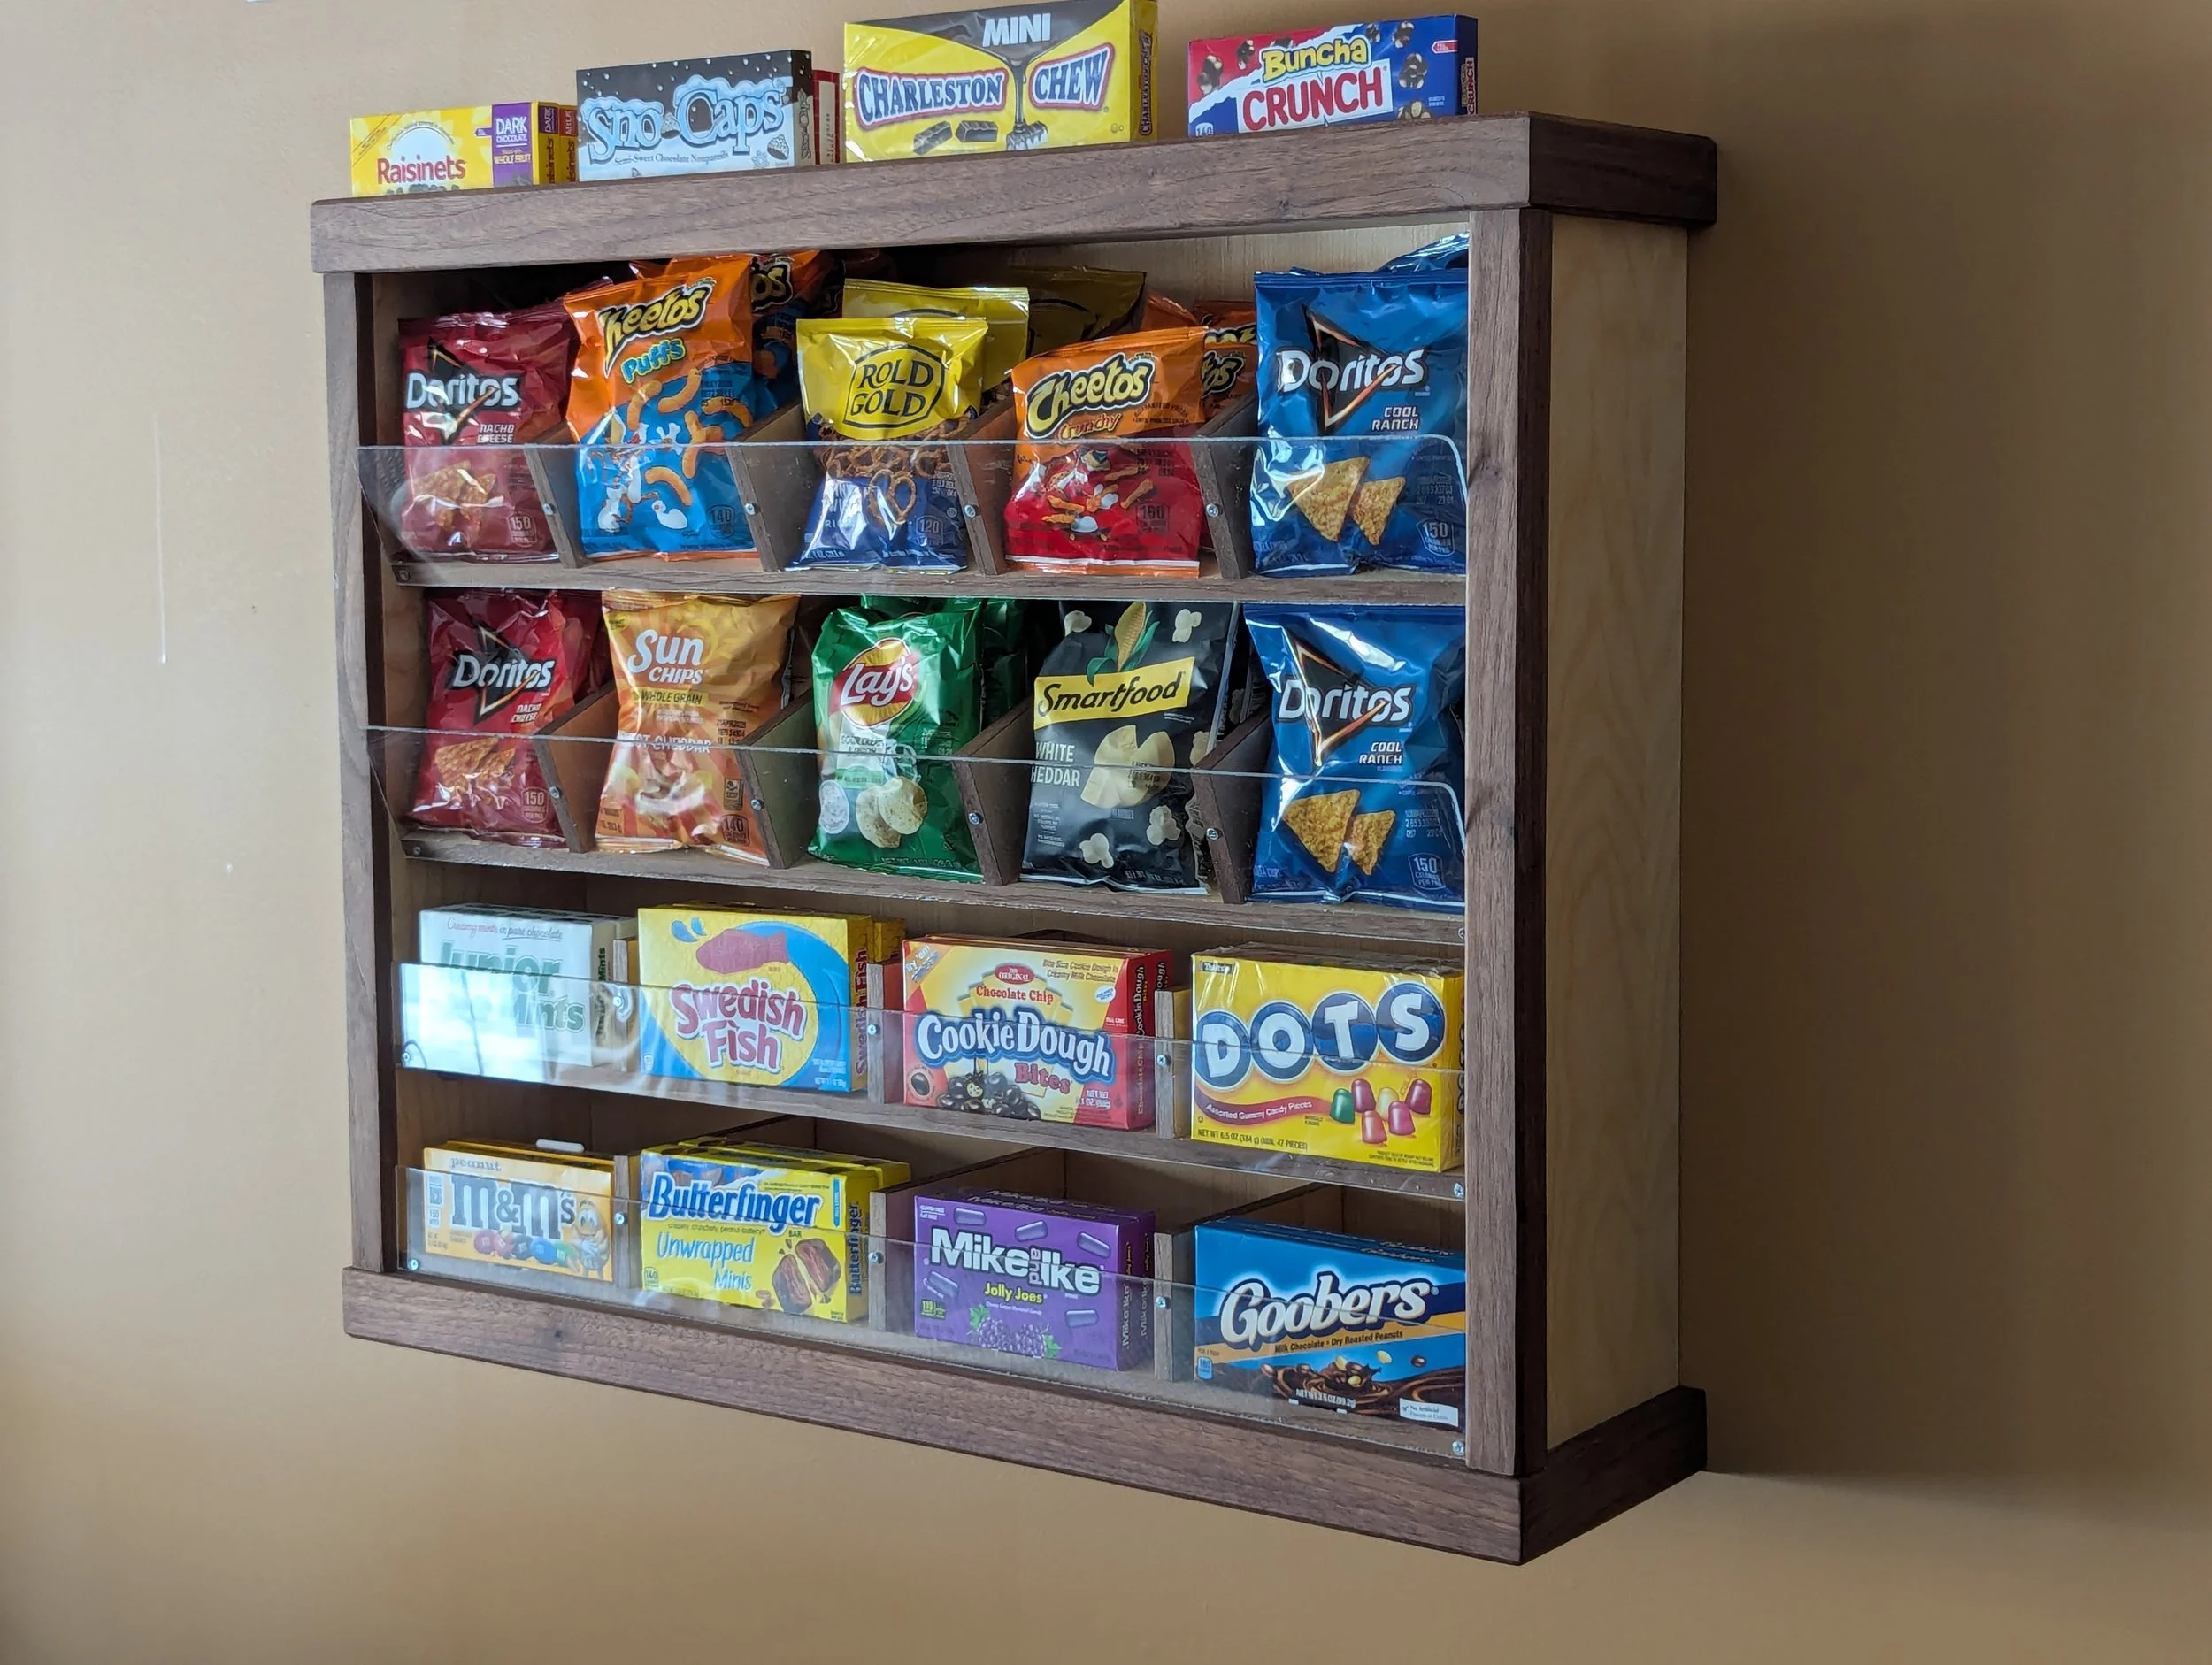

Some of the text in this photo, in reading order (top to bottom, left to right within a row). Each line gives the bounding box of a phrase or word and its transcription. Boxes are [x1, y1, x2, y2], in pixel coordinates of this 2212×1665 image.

[982, 13, 1051, 47] MINI
[1263, 38, 1369, 84] Buncha
[857, 49, 1108, 122] CHARLESTON CHEW
[1242, 67, 1383, 131] CRUNCH
[1466, 60, 1475, 114] CRUNCH
[495, 117, 528, 135] DARK
[495, 134, 528, 143] CHOCOLATE
[377, 154, 467, 184] Raisinets
[656, 153, 689, 163] Chocolate
[599, 288, 708, 372] heetos
[621, 339, 686, 383] Puffs
[856, 358, 934, 389] ROLD
[1278, 349, 1426, 394] Doritos
[407, 372, 520, 410] Doritos
[849, 389, 926, 418] GOLD
[1027, 358, 1152, 434] Cheetos
[1372, 418, 1419, 431] RANCH
[1384, 406, 1418, 418] COOL
[477, 434, 514, 443] CEESE
[480, 424, 515, 433] NACHO
[1058, 412, 1122, 442] Crunchy
[510, 516, 532, 530] 150
[919, 518, 940, 533] 120
[1423, 522, 1448, 538] 150
[626, 629, 704, 674] Sun
[452, 654, 555, 689] Doritos
[648, 666, 704, 685] CHIPS
[841, 656, 915, 707] Lay's
[641, 690, 703, 705] WHOLE GRAIN
[1037, 670, 1184, 717] Smartfood
[1279, 679, 1412, 722] Doritos
[1035, 741, 1076, 763] WHITE
[1359, 753, 1402, 765] RANCH
[1371, 741, 1402, 752] COOL
[1030, 765, 1081, 787] HEDDAR
[524, 791, 545, 806] 150
[1414, 856, 1438, 873] 150
[526, 925, 563, 939] chocolate
[855, 948, 867, 993] Fish
[998, 972, 1031, 982] ORIGINAL
[1156, 962, 1166, 991] ough
[670, 978, 806, 1037] Swedish
[976, 985, 1054, 1005] Chocolate Chip
[704, 1019, 780, 1069] Fish
[1202, 992, 1430, 1078] DOTS
[1014, 1062, 1071, 1095] Bites
[1206, 1101, 1313, 1120] Assorted Gummy Candy Pieces
[1230, 1132, 1239, 1141] OZ
[450, 1157, 503, 1172] peanut
[649, 1171, 822, 1233] Butterfinger
[788, 1230, 803, 1239] BAR
[849, 1203, 862, 1294] Butterfinger
[657, 1231, 756, 1268] Unwrapped
[931, 1228, 1100, 1294] Mike and Ike
[715, 1268, 753, 1290] Minis
[984, 1282, 1043, 1304] Jolly Joes
[1220, 1272, 1432, 1347] Goobers
[1274, 1330, 1403, 1353] Milk Chocolate Dry Roasted Peanuts
